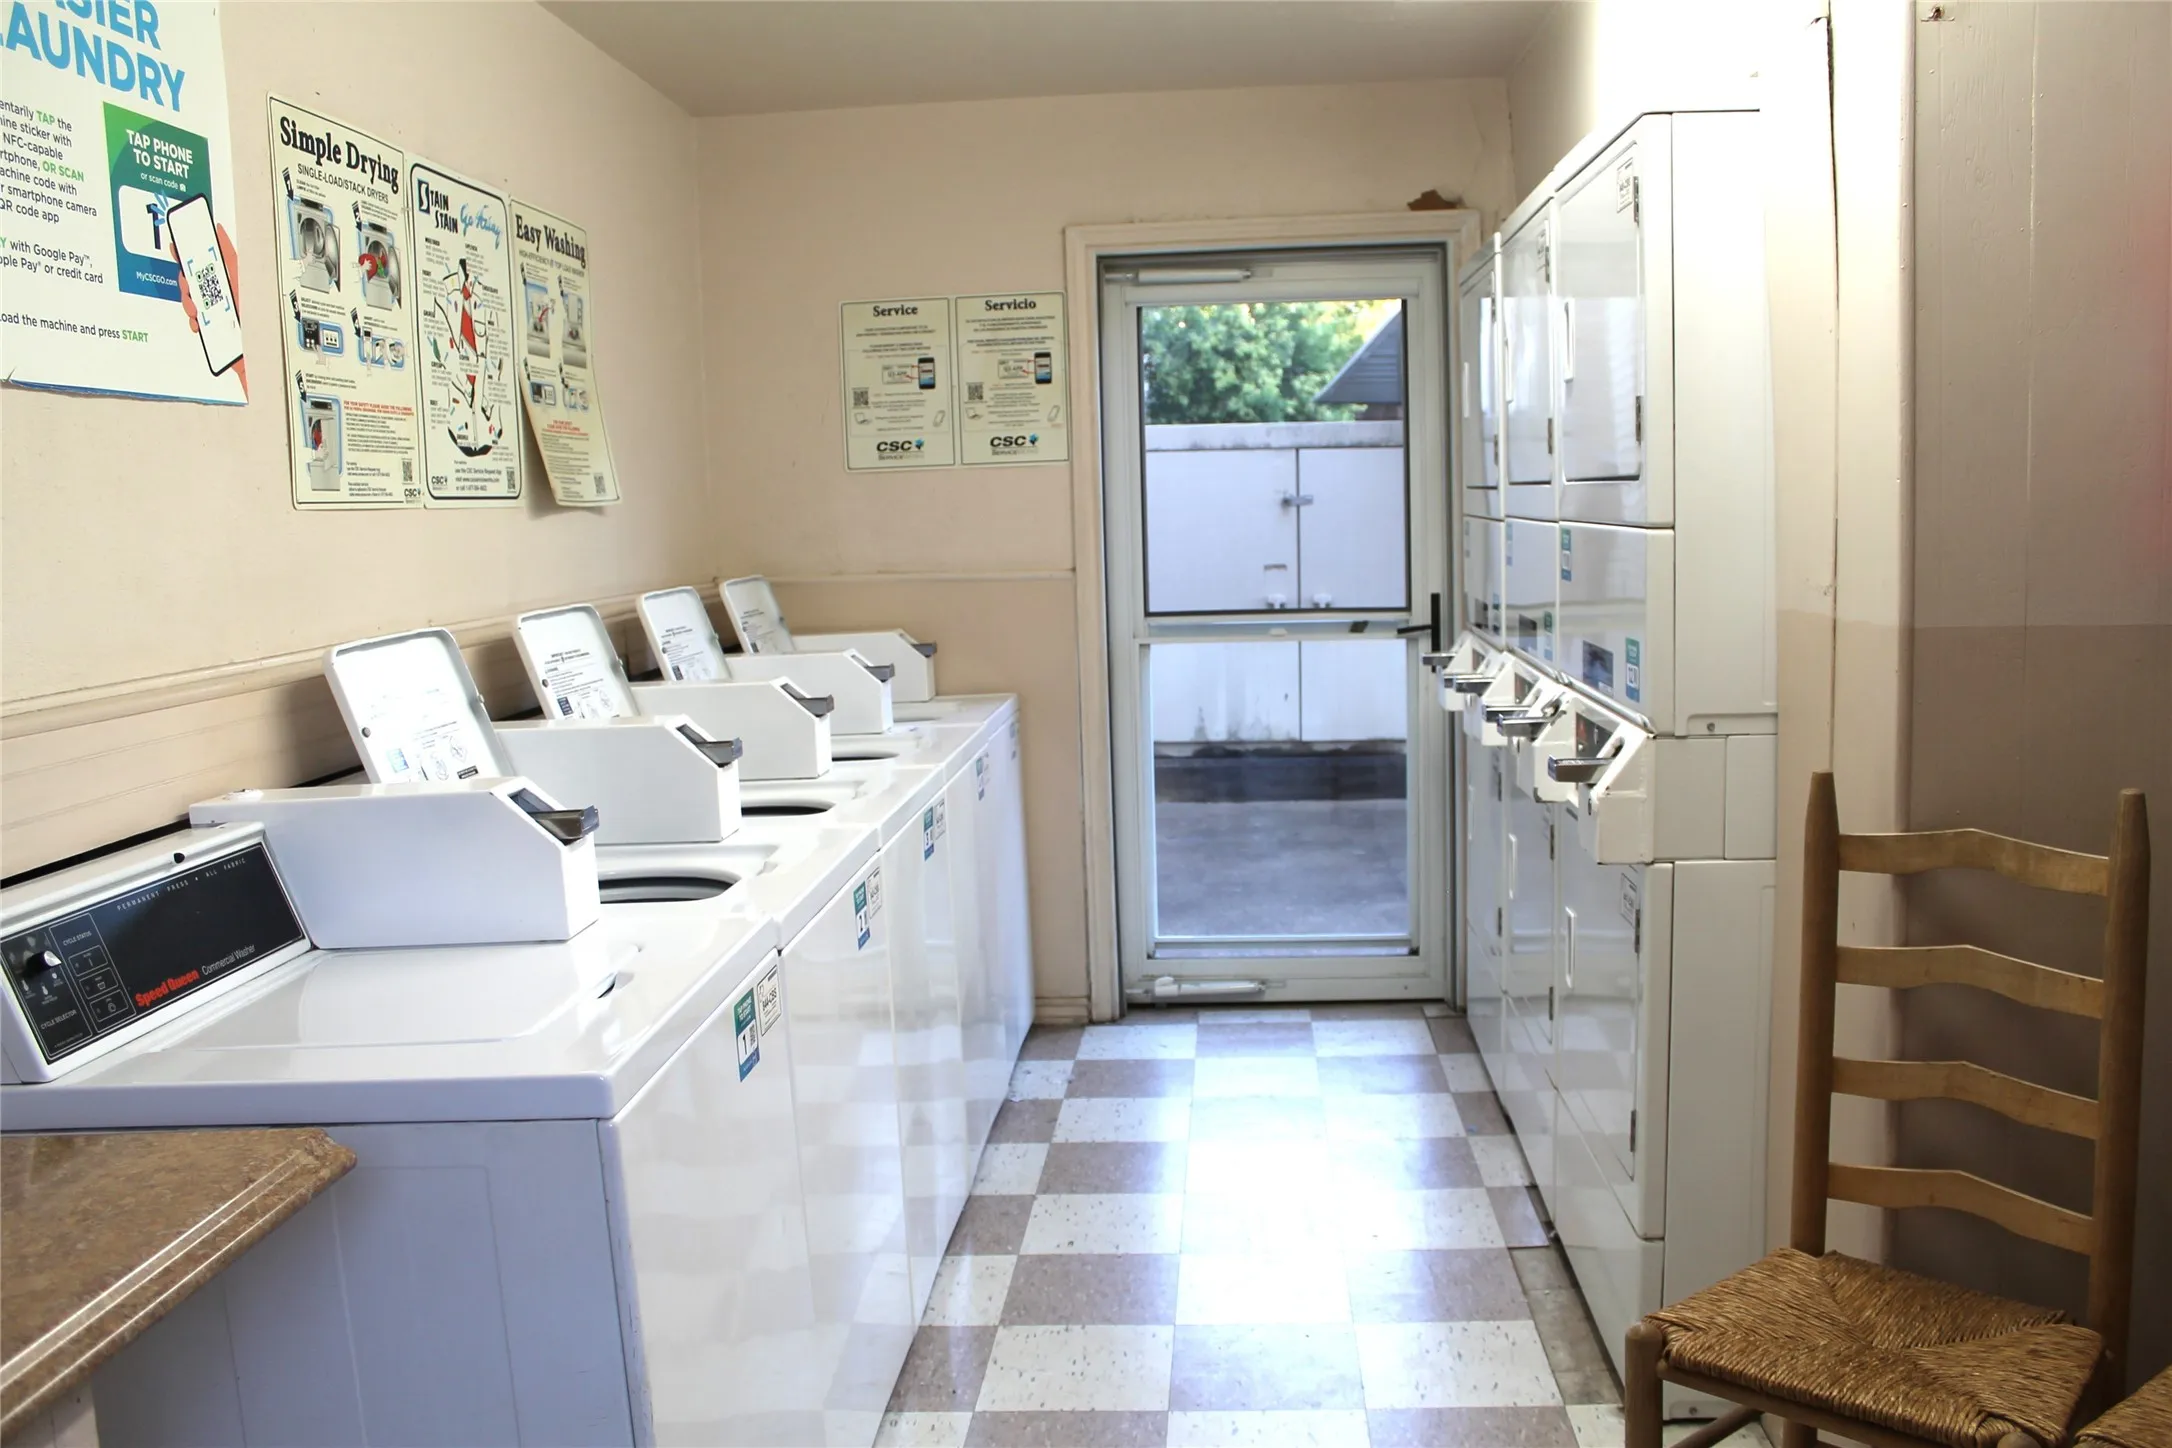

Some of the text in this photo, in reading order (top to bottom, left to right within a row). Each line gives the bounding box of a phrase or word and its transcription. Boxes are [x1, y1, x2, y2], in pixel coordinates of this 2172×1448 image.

[0, 1, 186, 112] AUNDRY
[36, 110, 56, 125] TAP
[57, 118, 72, 132] the
[3, 132, 63, 160] NFC-capable
[20, 123, 50, 140] sticker
[53, 133, 72, 147] with
[126, 129, 193, 165] TAP PHONE
[280, 116, 399, 195] Simple Drying
[42, 161, 56, 174] OR
[59, 165, 84, 182] SCAN
[133, 148, 190, 179] TO START
[34, 176, 56, 190] code
[58, 182, 77, 196] with
[140, 172, 179, 190] or scan code
[8, 185, 63, 208] smartphone
[66, 200, 97, 217] camera
[366, 185, 389, 204] DRYERS
[417, 179, 449, 212] STAIN
[16, 204, 39, 218] code
[42, 210, 59, 224] app
[435, 210, 458, 233] STAIN
[10, 240, 31, 254] with
[34, 244, 66, 262] Google
[515, 213, 586, 269] Easy Washing
[45, 264, 54, 274] or
[57, 266, 82, 280] credit
[84, 273, 103, 284] card
[872, 304, 918, 317] Service
[985, 299, 1037, 312] Servicio
[0, 313, 149, 343] oad the machine and press START
[876, 440, 912, 453] CSC
[990, 435, 1027, 448] CSC
[431, 476, 444, 484] CSC
[404, 489, 417, 497] CSC
[117, 857, 246, 911] PERMANENT PRESS ALL FABRIC
[134, 944, 256, 1007] Speed Queen Commercial Washer
[41, 1009, 77, 1030] CYCLE SELECTOR
